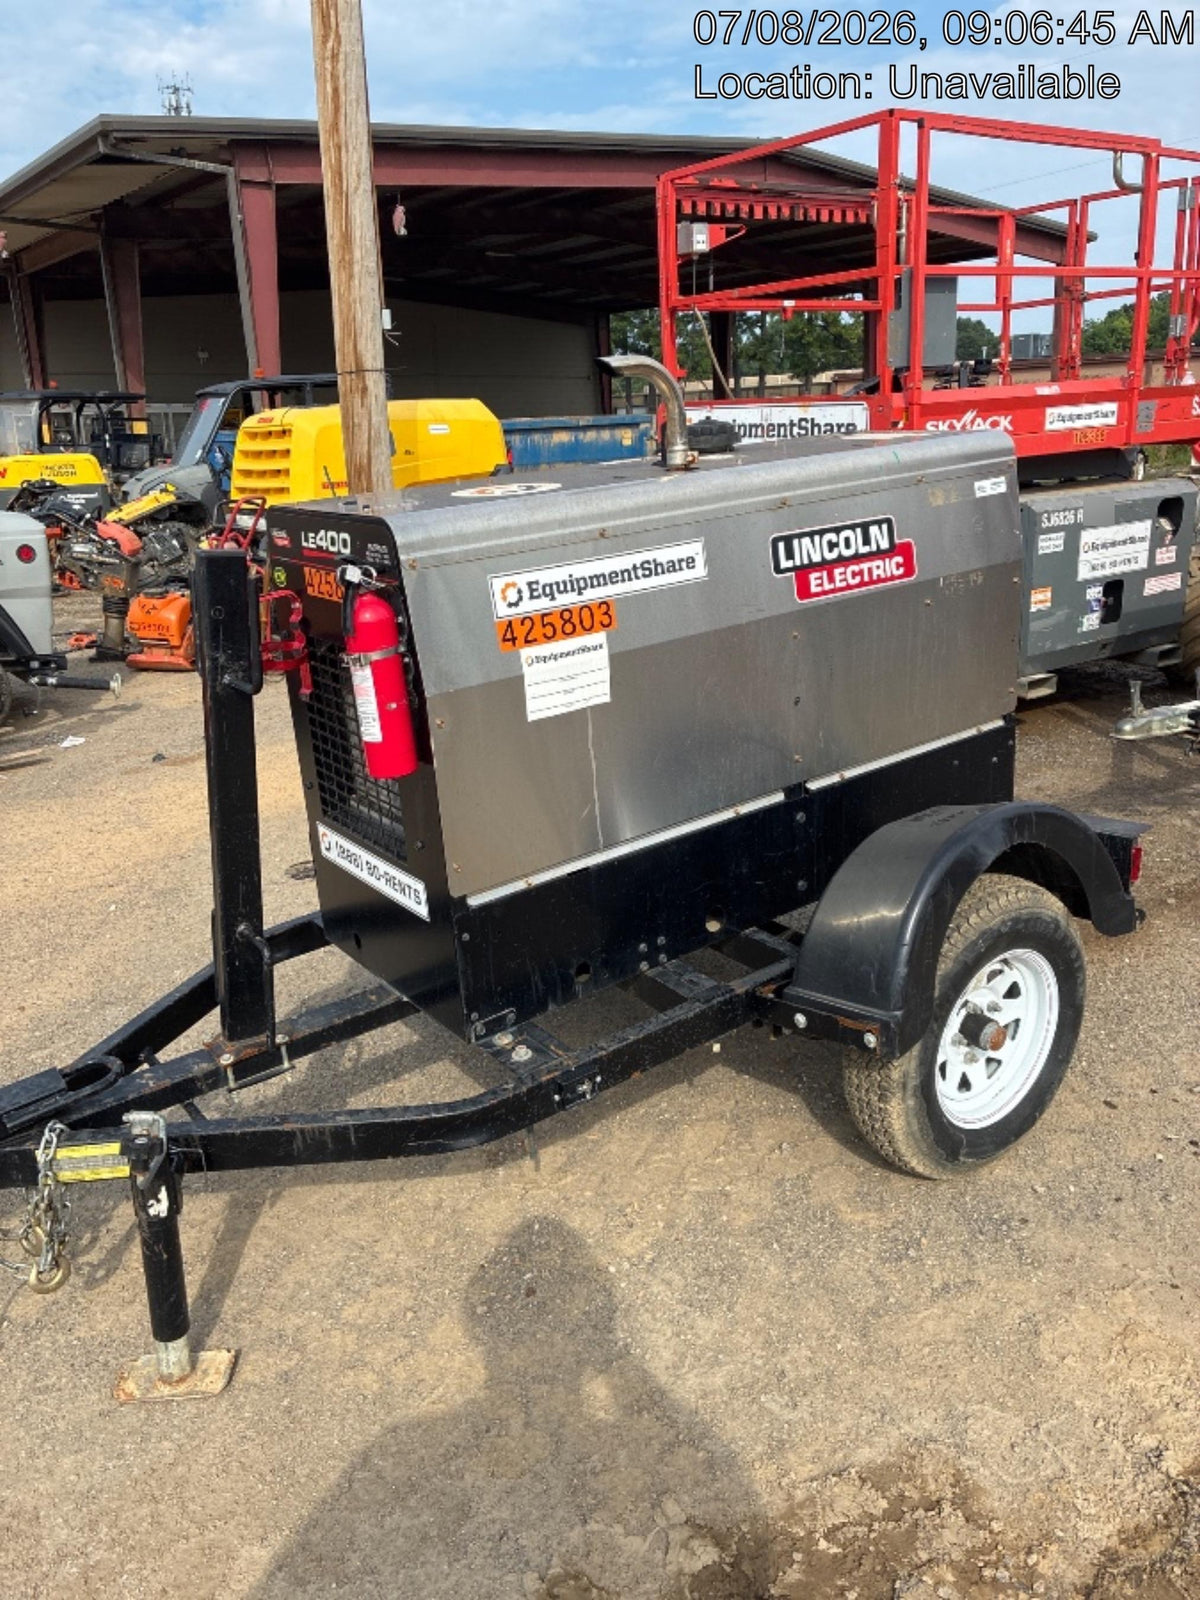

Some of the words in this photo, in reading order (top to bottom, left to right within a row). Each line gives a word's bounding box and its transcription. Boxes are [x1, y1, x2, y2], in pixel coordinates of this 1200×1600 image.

[301, 529, 351, 555] LE400
[777, 522, 890, 570] LINCOLN
[526, 555, 696, 601] EquipmentShare
[808, 555, 905, 594] ELECTRIC
[501, 600, 613, 647] 425803
